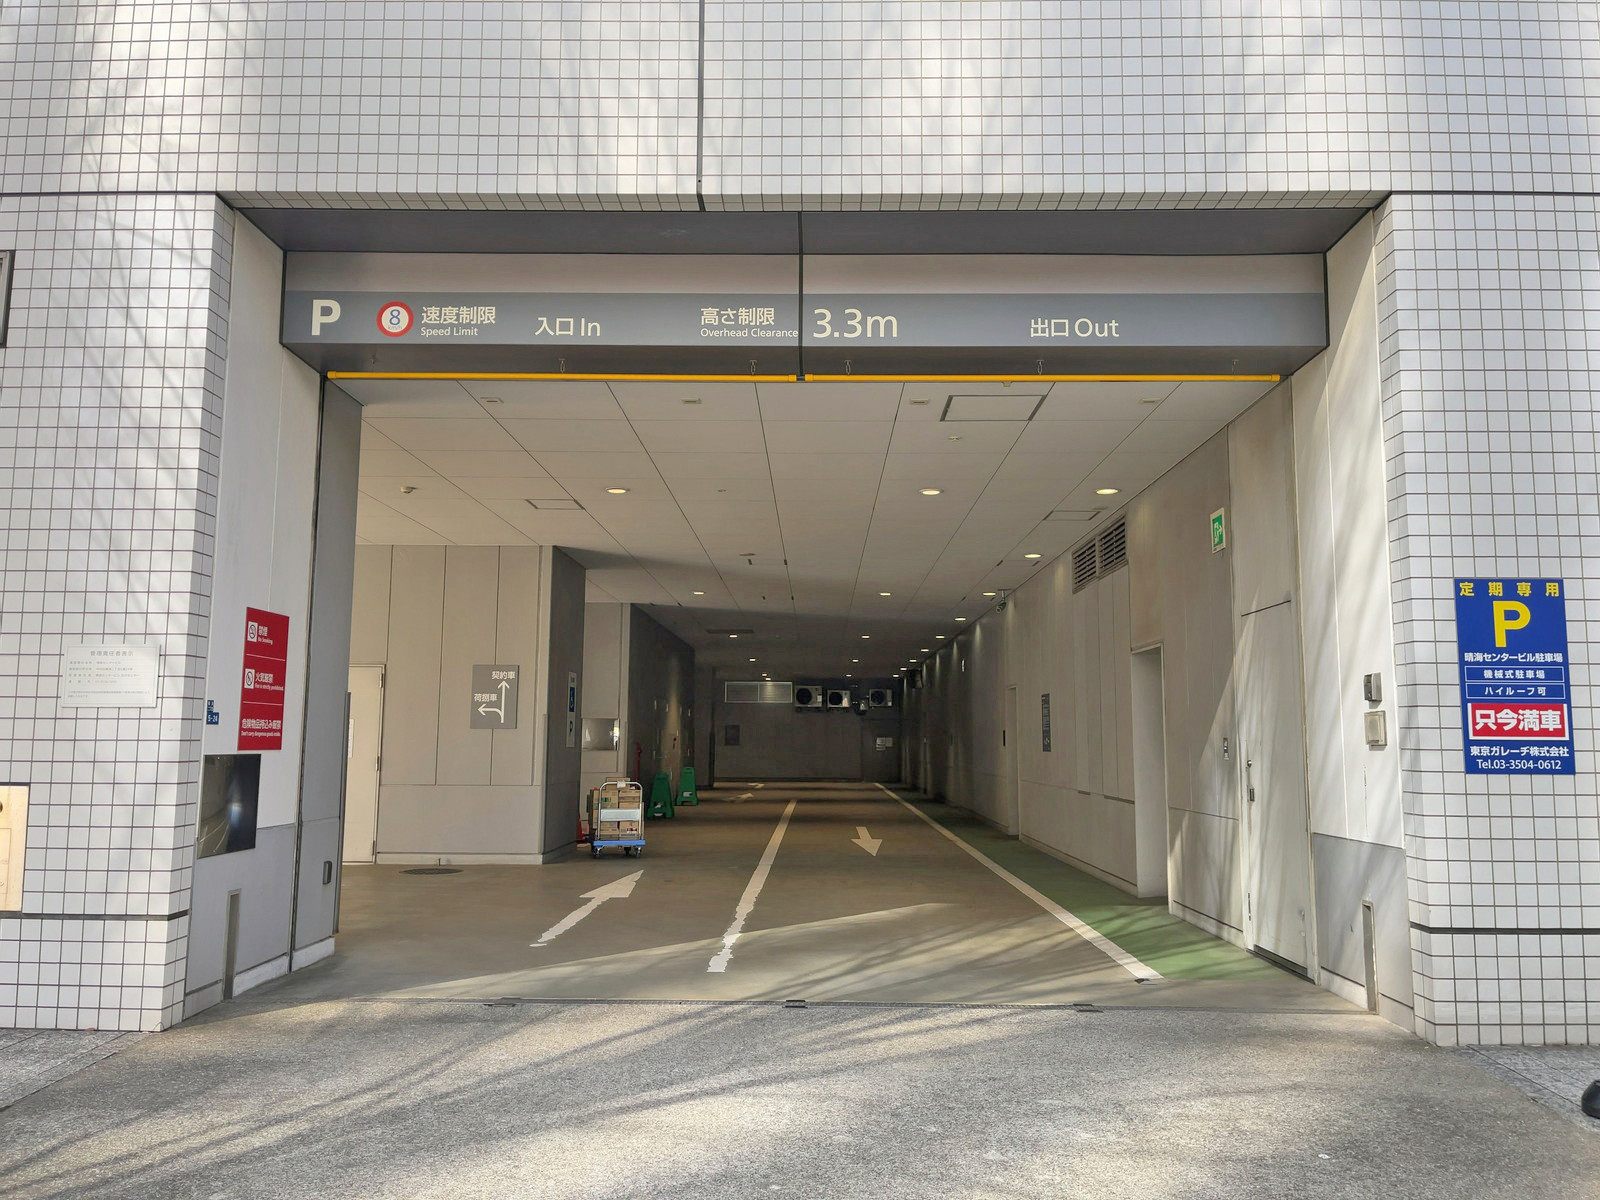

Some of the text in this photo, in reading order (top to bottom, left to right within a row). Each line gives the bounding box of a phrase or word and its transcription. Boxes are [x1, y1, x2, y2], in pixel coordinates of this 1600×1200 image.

[311, 299, 341, 336] P
[389, 309, 401, 326] 8
[421, 305, 496, 324] 速度制限
[700, 307, 775, 326] 高さ制限
[813, 308, 899, 338] 3.3m
[421, 326, 478, 337] Speed Limit
[534, 316, 601, 337] 入口 In
[700, 327, 799, 338] Overhead Clearance
[1030, 318, 1120, 338] 出口 Out
[1459, 581, 1560, 597] 定期専用
[1492, 600, 1531, 648] P
[1464, 652, 1563, 663] 晴海センタービル駐車場
[491, 670, 516, 680] 契約車
[1483, 669, 1545, 680] 機械式駐車場
[1484, 686, 1546, 697] ハイルーフ可
[1475, 708, 1562, 731] 只今満車
[1476, 758, 1562, 771] Tel.03-3504-0612
